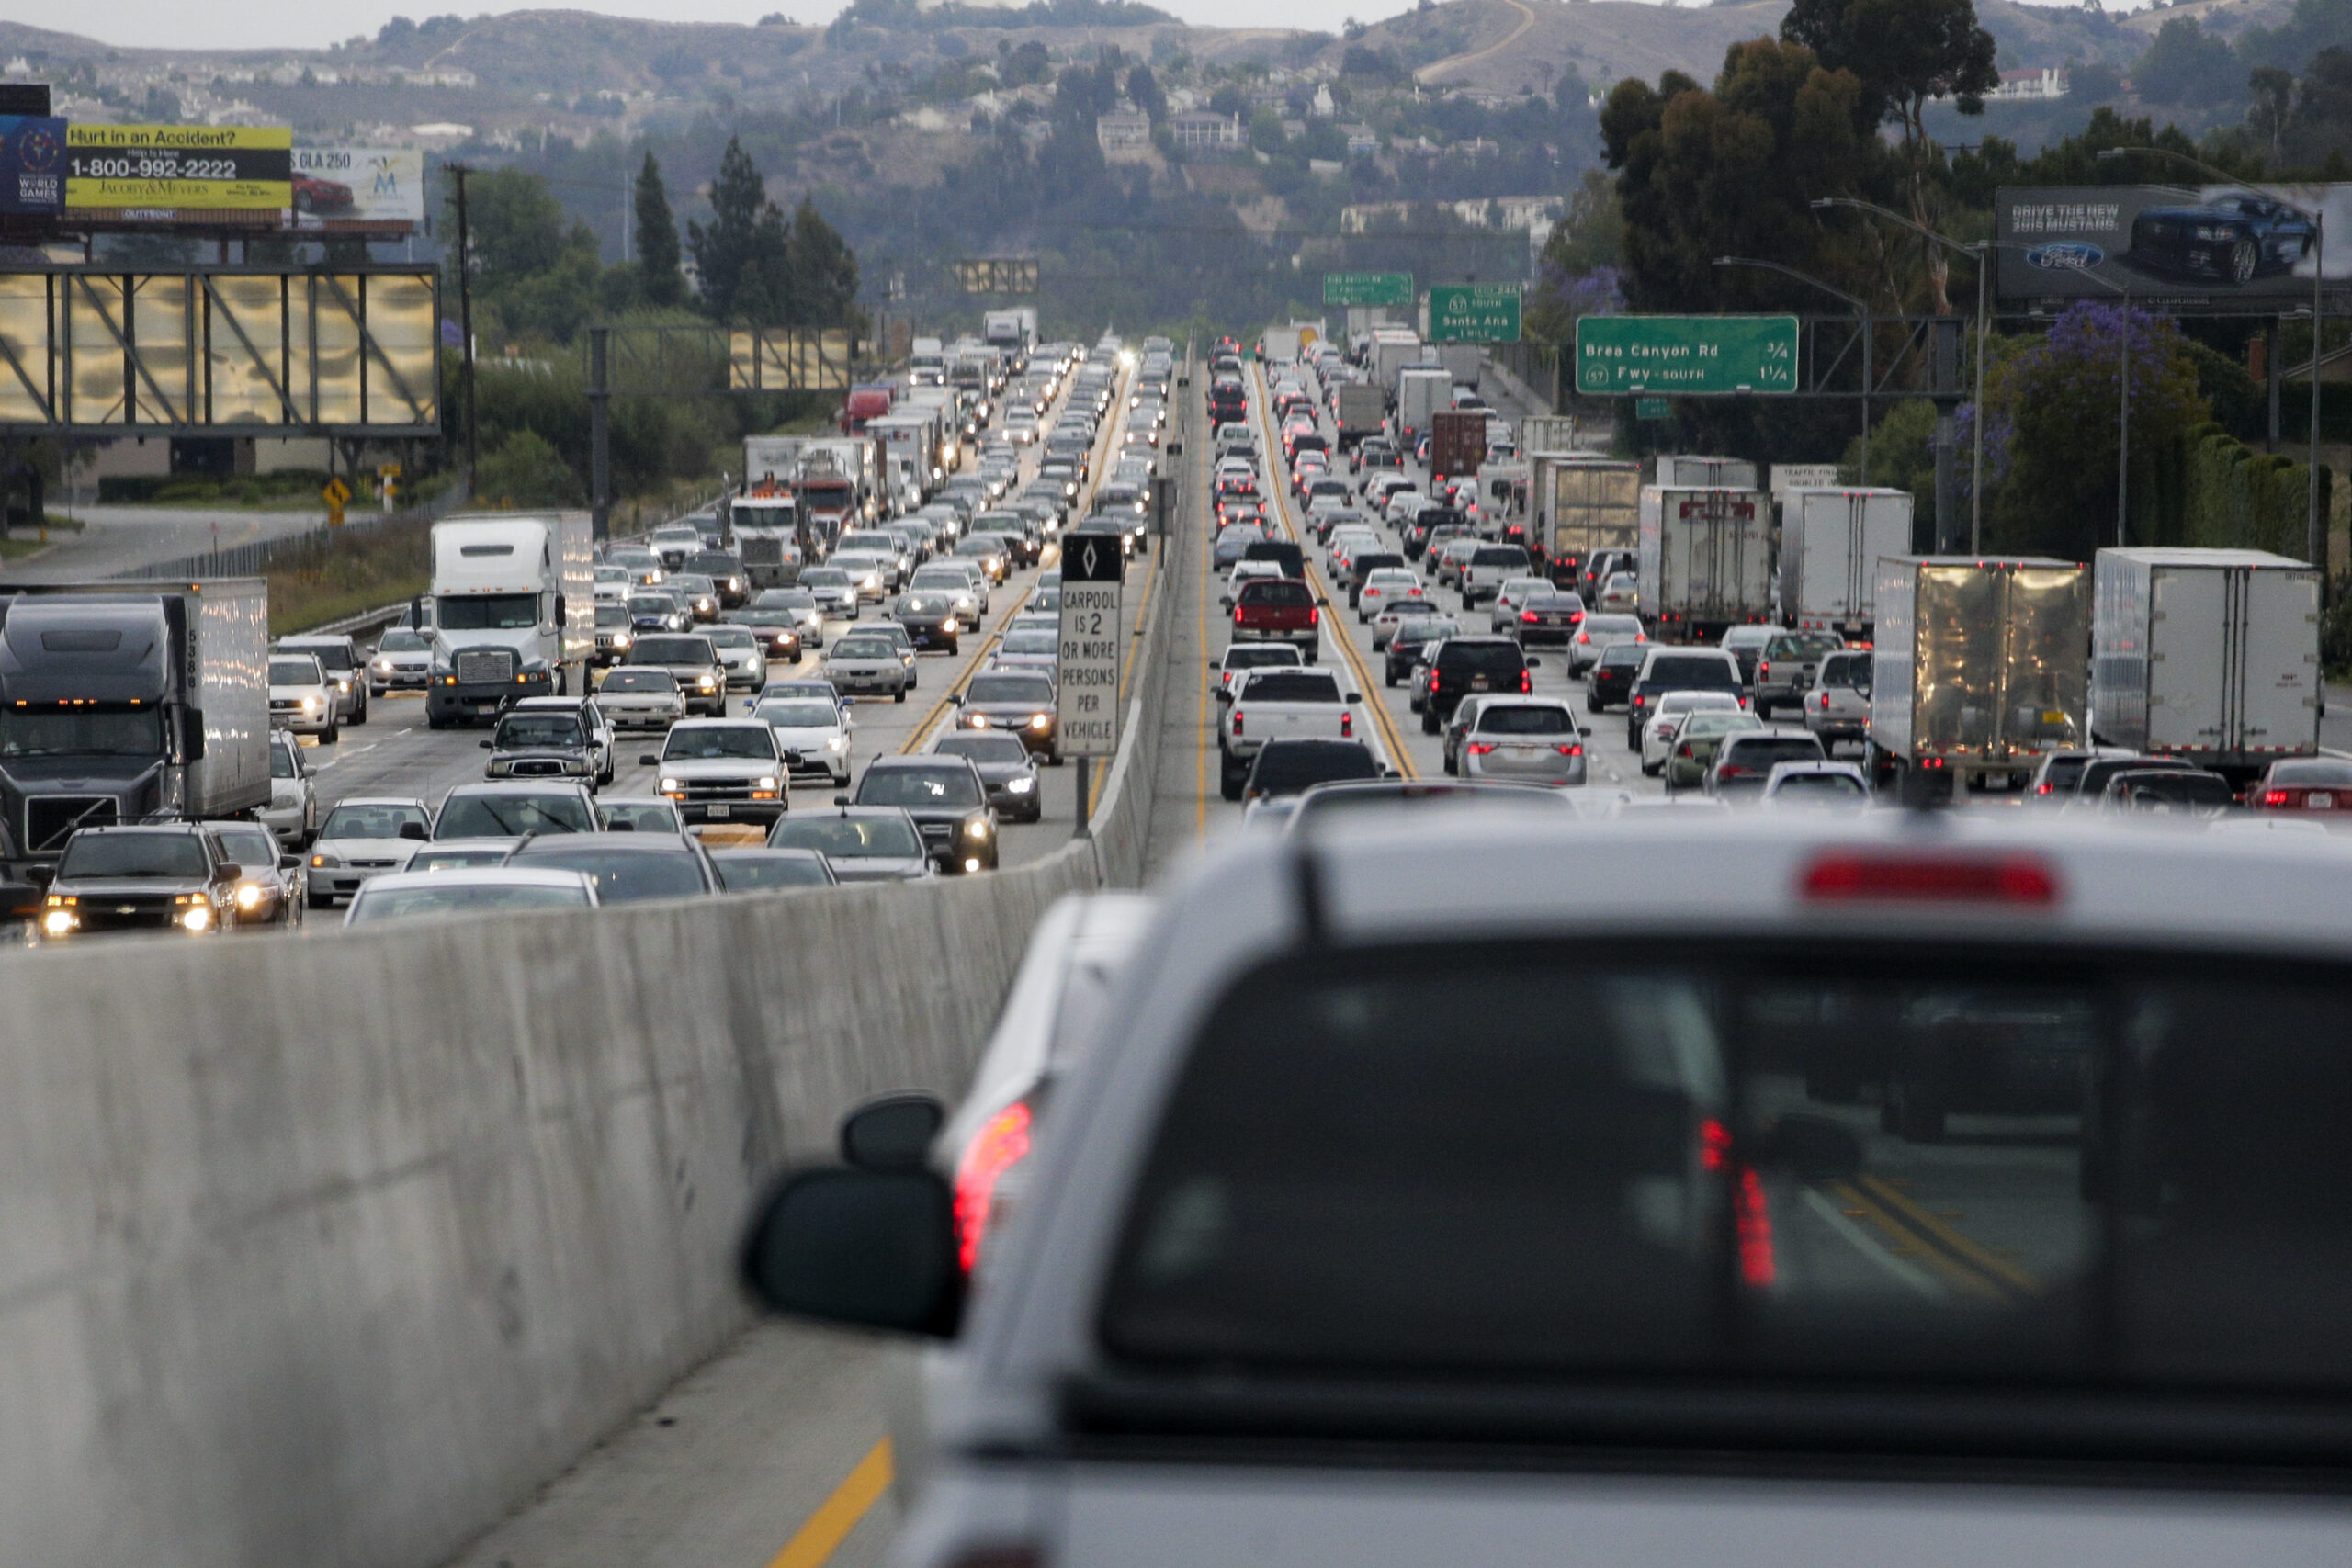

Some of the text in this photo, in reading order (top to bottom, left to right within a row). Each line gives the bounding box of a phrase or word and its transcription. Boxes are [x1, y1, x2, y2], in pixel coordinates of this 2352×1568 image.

[71, 129, 236, 145] Hurt in an Accident?
[71, 158, 236, 179] 1-800-992-2222
[300, 151, 324, 168] GLA
[326, 152, 351, 169] 250
[20, 188, 58, 198] GAMES
[2012, 204, 2119, 217] DRIVE THE NEW
[1442, 316, 1508, 327] Santa Ana
[1585, 344, 1623, 357] Brea
[1631, 344, 1690, 360] Canyon
[1699, 344, 1718, 357] Rd
[1590, 370, 1604, 381] 57
[1063, 591, 1117, 611] CARPOOL
[1074, 613, 1102, 636] IS 2
[1062, 641, 1115, 660] OR MORE
[1062, 669, 1115, 686] PERSONS
[1077, 694, 1100, 712] PER
[1064, 722, 1112, 740] VEHICLE
